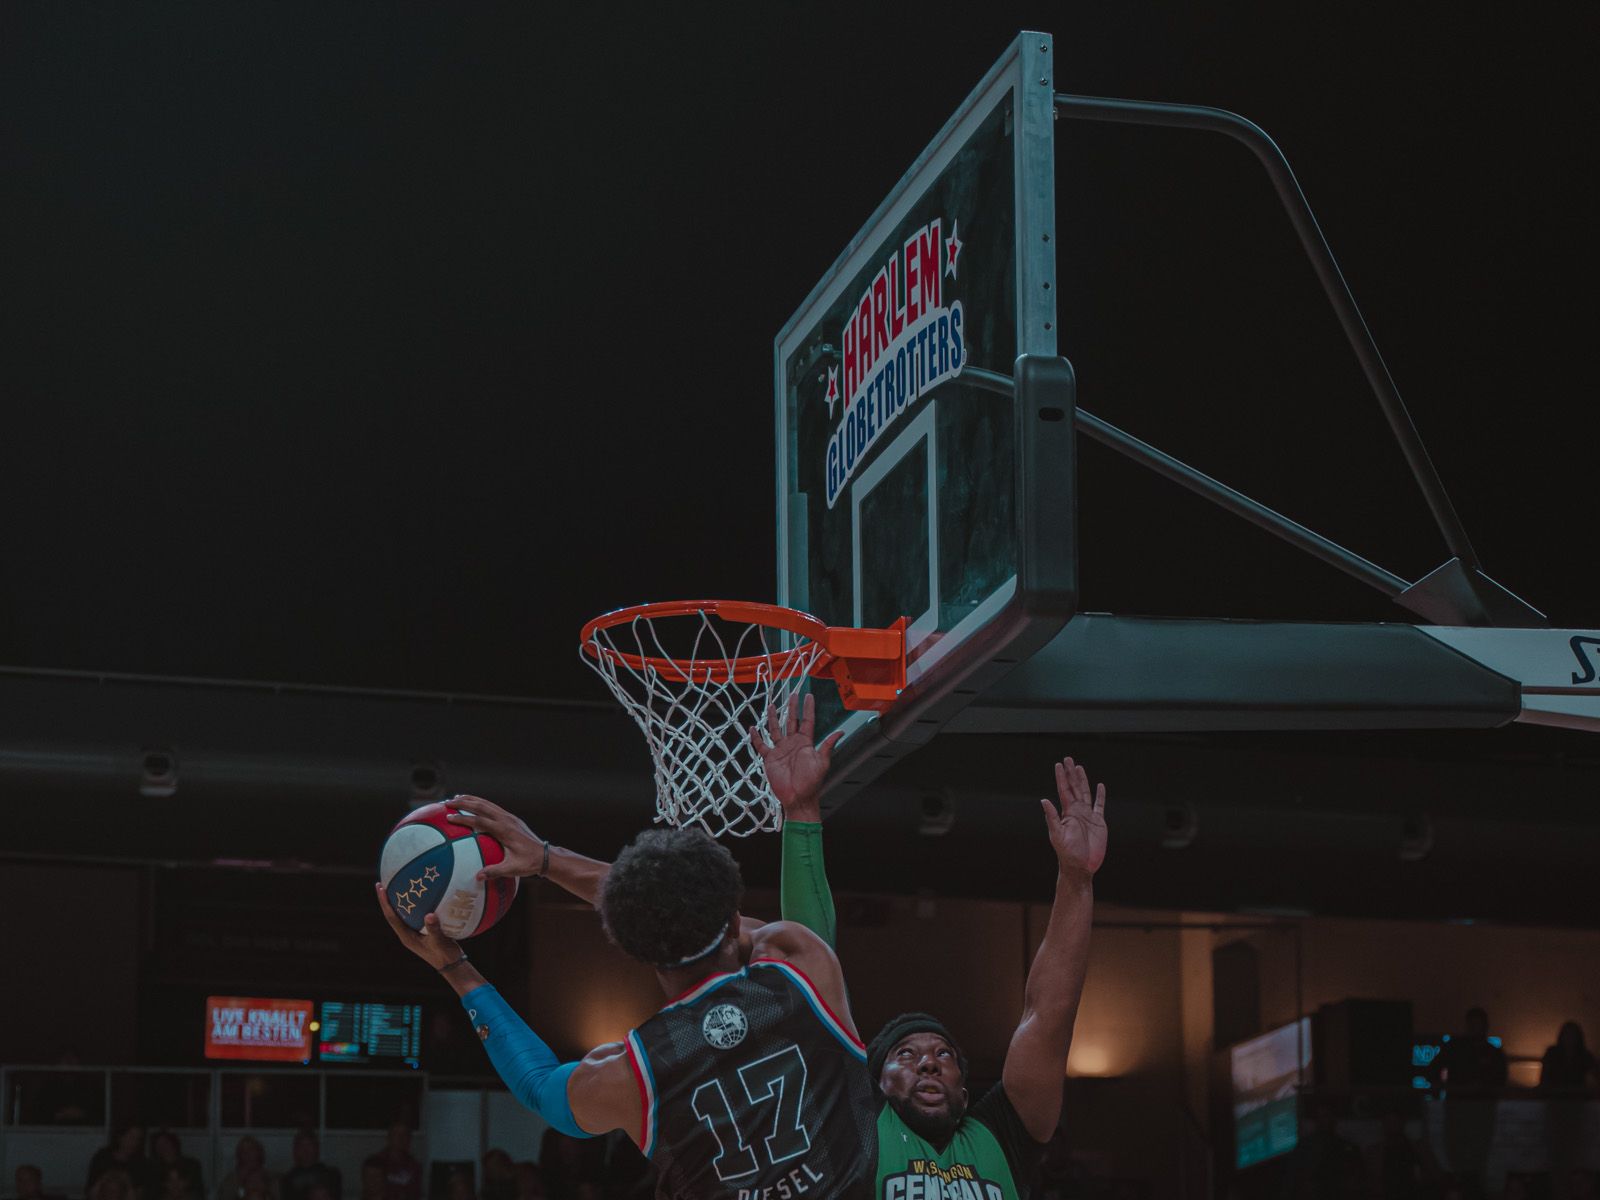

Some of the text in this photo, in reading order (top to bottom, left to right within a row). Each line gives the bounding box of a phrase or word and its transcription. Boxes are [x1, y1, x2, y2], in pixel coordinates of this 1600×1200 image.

[843, 223, 941, 409] HARLEM
[827, 306, 962, 502] GLOBETROTTERS
[212, 1007, 244, 1024] LIVE
[212, 1021, 238, 1038] AM
[691, 1044, 811, 1182] 17
